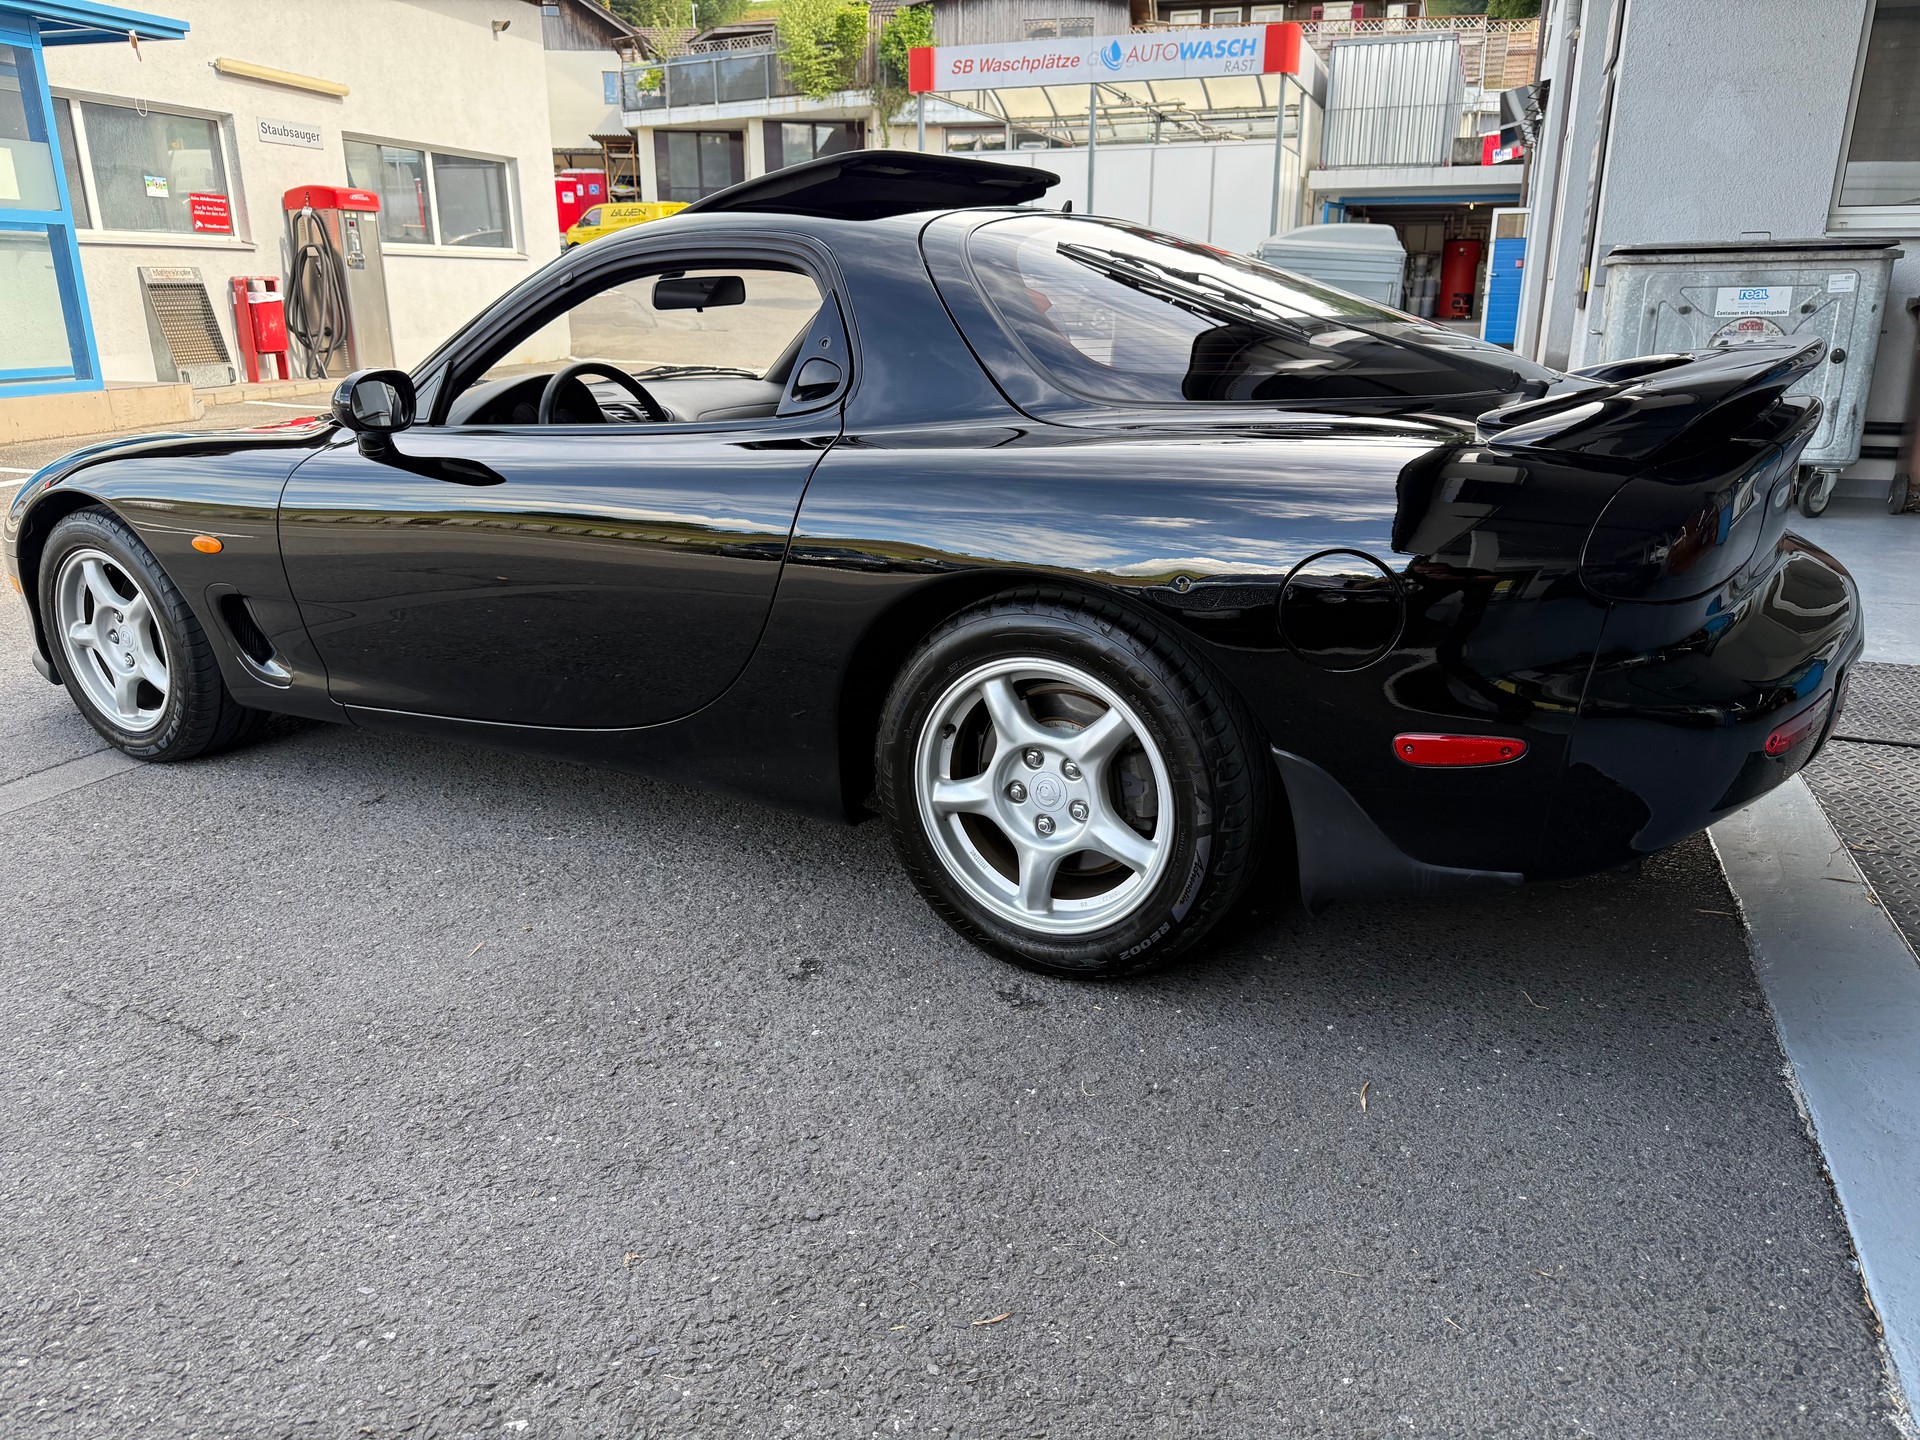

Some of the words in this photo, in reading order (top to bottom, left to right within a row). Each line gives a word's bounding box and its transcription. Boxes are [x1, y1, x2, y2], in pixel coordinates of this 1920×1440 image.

[1126, 38, 1257, 63] AUTOWASCH
[951, 59, 974, 75] SB
[979, 54, 1080, 74] Waschplätze
[1224, 59, 1256, 73] RAST
[260, 121, 320, 143] Staubsauger
[610, 208, 647, 217] GILGEN
[1738, 288, 1770, 300] real
[1119, 921, 1171, 961] RE002
